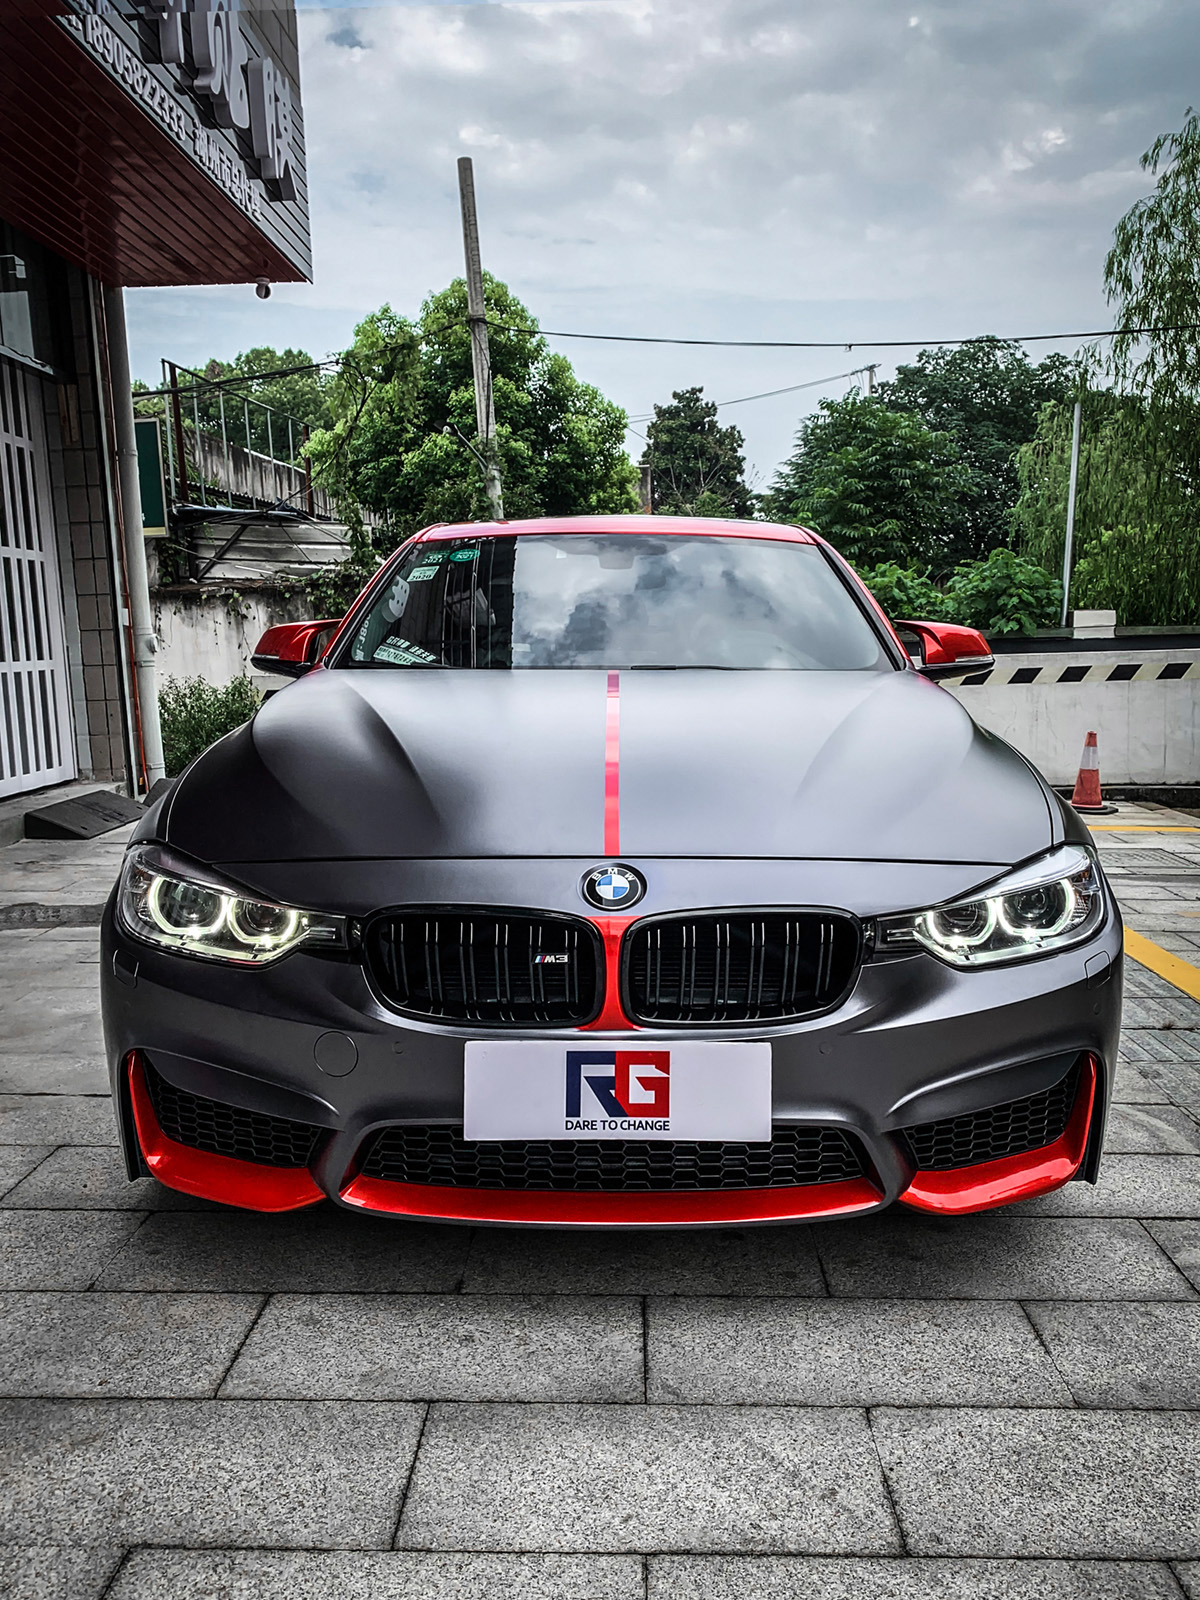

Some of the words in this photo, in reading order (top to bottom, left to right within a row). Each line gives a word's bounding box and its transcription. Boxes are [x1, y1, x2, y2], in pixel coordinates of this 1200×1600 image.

[591, 867, 636, 881] BMW
[565, 1050, 670, 1118] RG
[565, 1119, 598, 1131] DARE
[600, 1119, 618, 1131] TO
[620, 1119, 670, 1131] CHANGE
